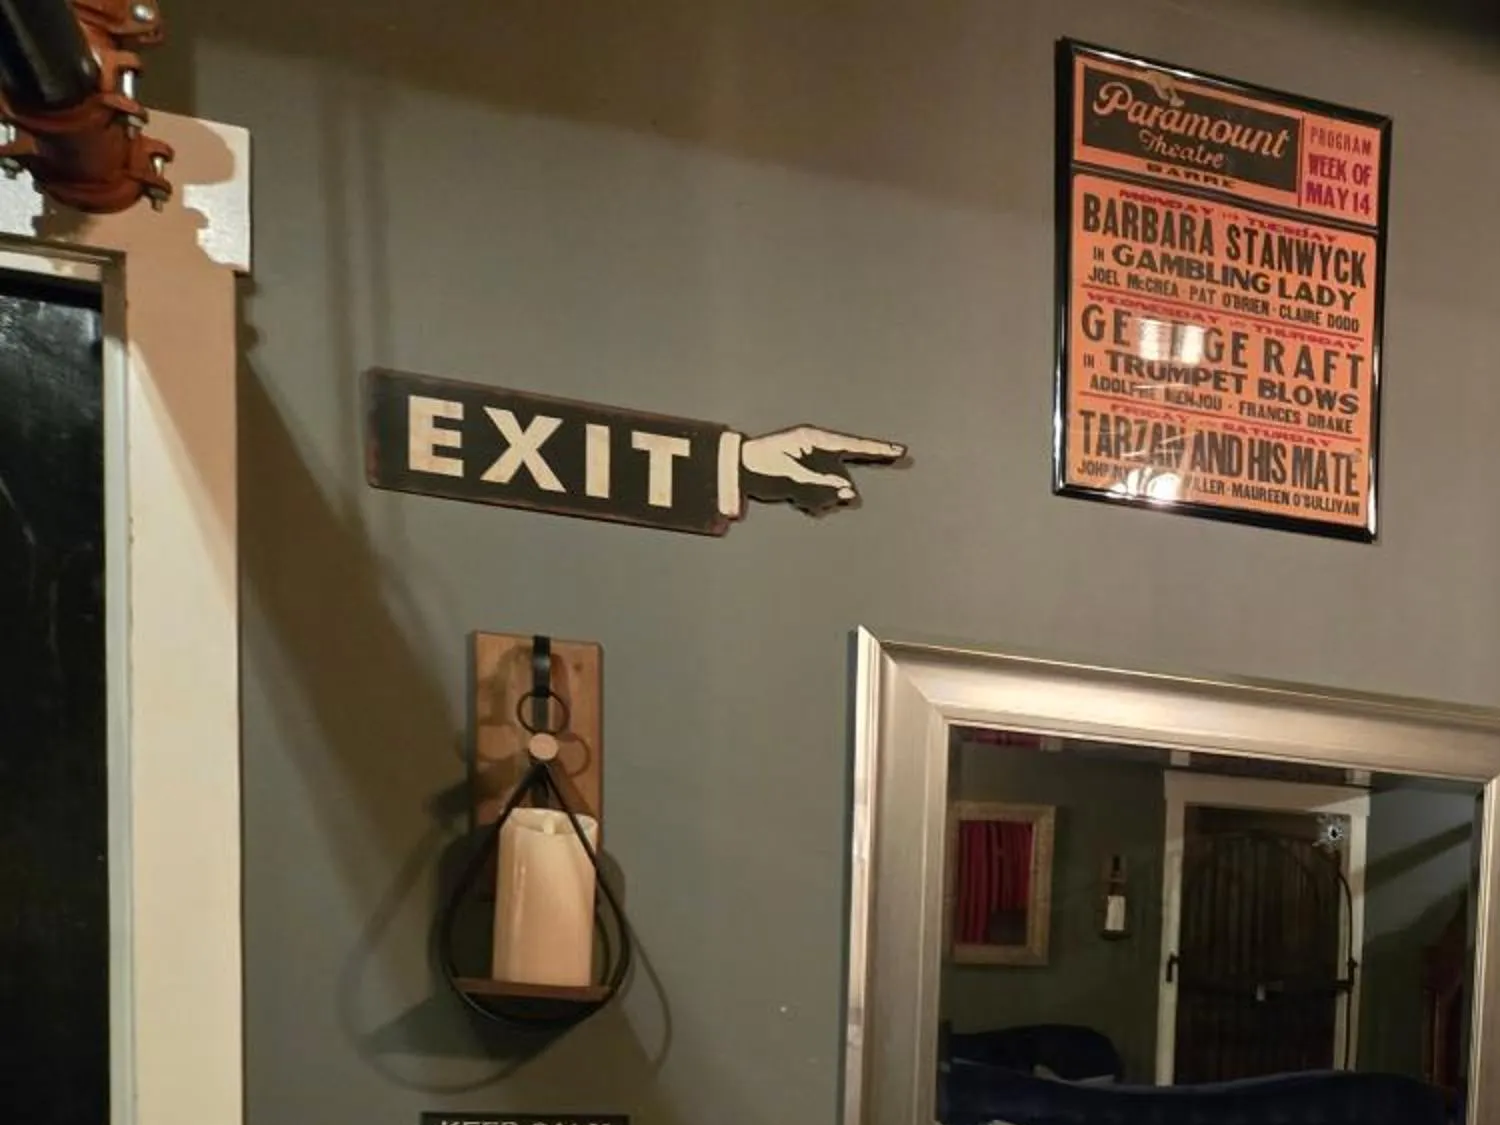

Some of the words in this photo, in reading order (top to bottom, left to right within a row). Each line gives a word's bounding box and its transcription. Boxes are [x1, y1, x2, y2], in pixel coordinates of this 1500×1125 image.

[1093, 81, 1290, 159] Paramount
[1139, 128, 1224, 168] Theatre
[1311, 126, 1371, 156] PROGRAM
[1306, 181, 1349, 210] MAY
[1353, 192, 1370, 215] 14
[1308, 152, 1347, 184] WEEK
[1352, 163, 1372, 188] OF
[1083, 192, 1214, 256] BARBARA
[1226, 223, 1366, 289] STANWYCK
[1088, 266, 1120, 287] JOEL
[1127, 272, 1179, 298] McCREA
[1190, 285, 1216, 305] PAT
[1222, 293, 1269, 316] O'BRIEN
[1279, 305, 1322, 326] CLAIRE
[1327, 313, 1359, 333] DODD
[1093, 246, 1104, 262] IN
[1112, 243, 1271, 294] GAMBLING
[1278, 277, 1357, 311] LADY
[1081, 304, 1249, 368] GEGE
[1263, 336, 1364, 389] RAFT
[1083, 353, 1094, 368] IN
[1104, 350, 1248, 394] TRUMPET
[1258, 378, 1359, 415] BLOWS
[1238, 400, 1301, 424] FRANCES
[1307, 412, 1353, 434] DRAKE
[408, 395, 690, 508] EXIT
[1079, 410, 1185, 469] TARZAN
[1190, 429, 1242, 477] AND
[1248, 437, 1287, 485] HIS
[1291, 445, 1360, 498] MATE
[1231, 482, 1290, 506] MAUREEN
[1293, 492, 1360, 517] O'SULLIVAN
